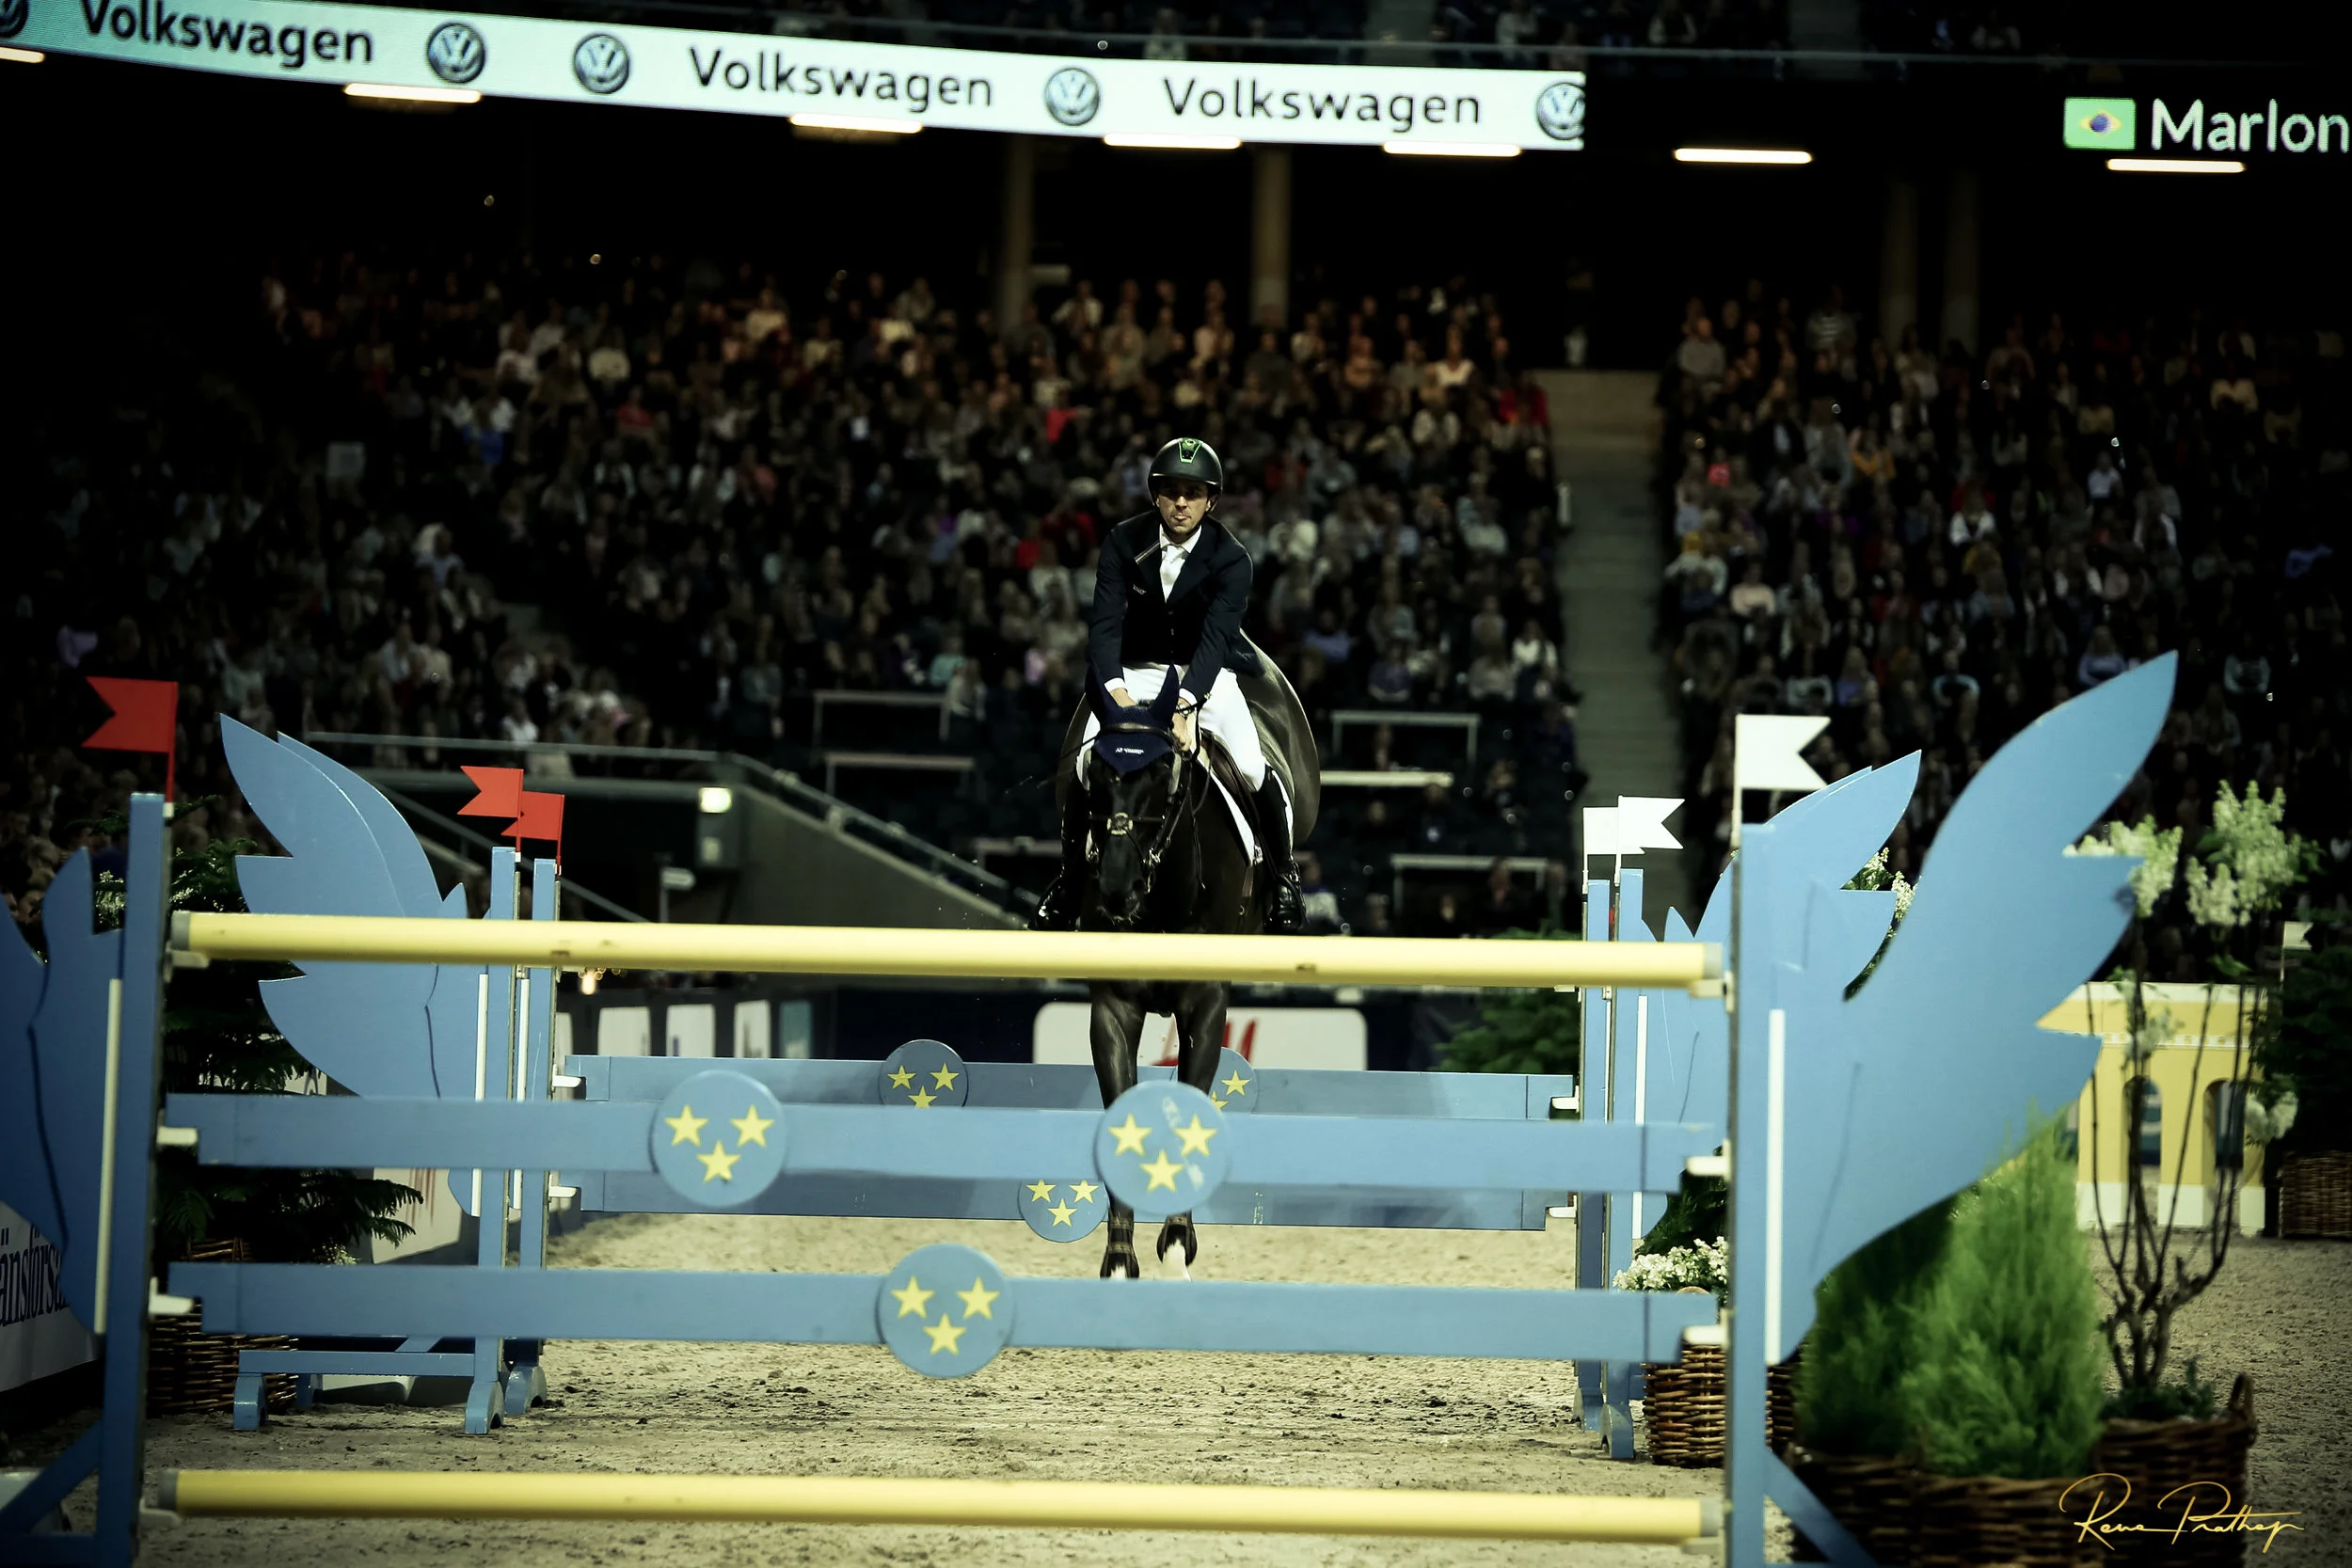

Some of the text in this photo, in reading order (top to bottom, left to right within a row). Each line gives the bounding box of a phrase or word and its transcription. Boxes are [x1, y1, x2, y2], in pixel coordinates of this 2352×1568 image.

[80, 0, 373, 69] Volkswagen
[690, 46, 992, 113] Volkswagen
[1164, 78, 1482, 134] Volkswagen
[2151, 98, 2350, 153] Marlon
